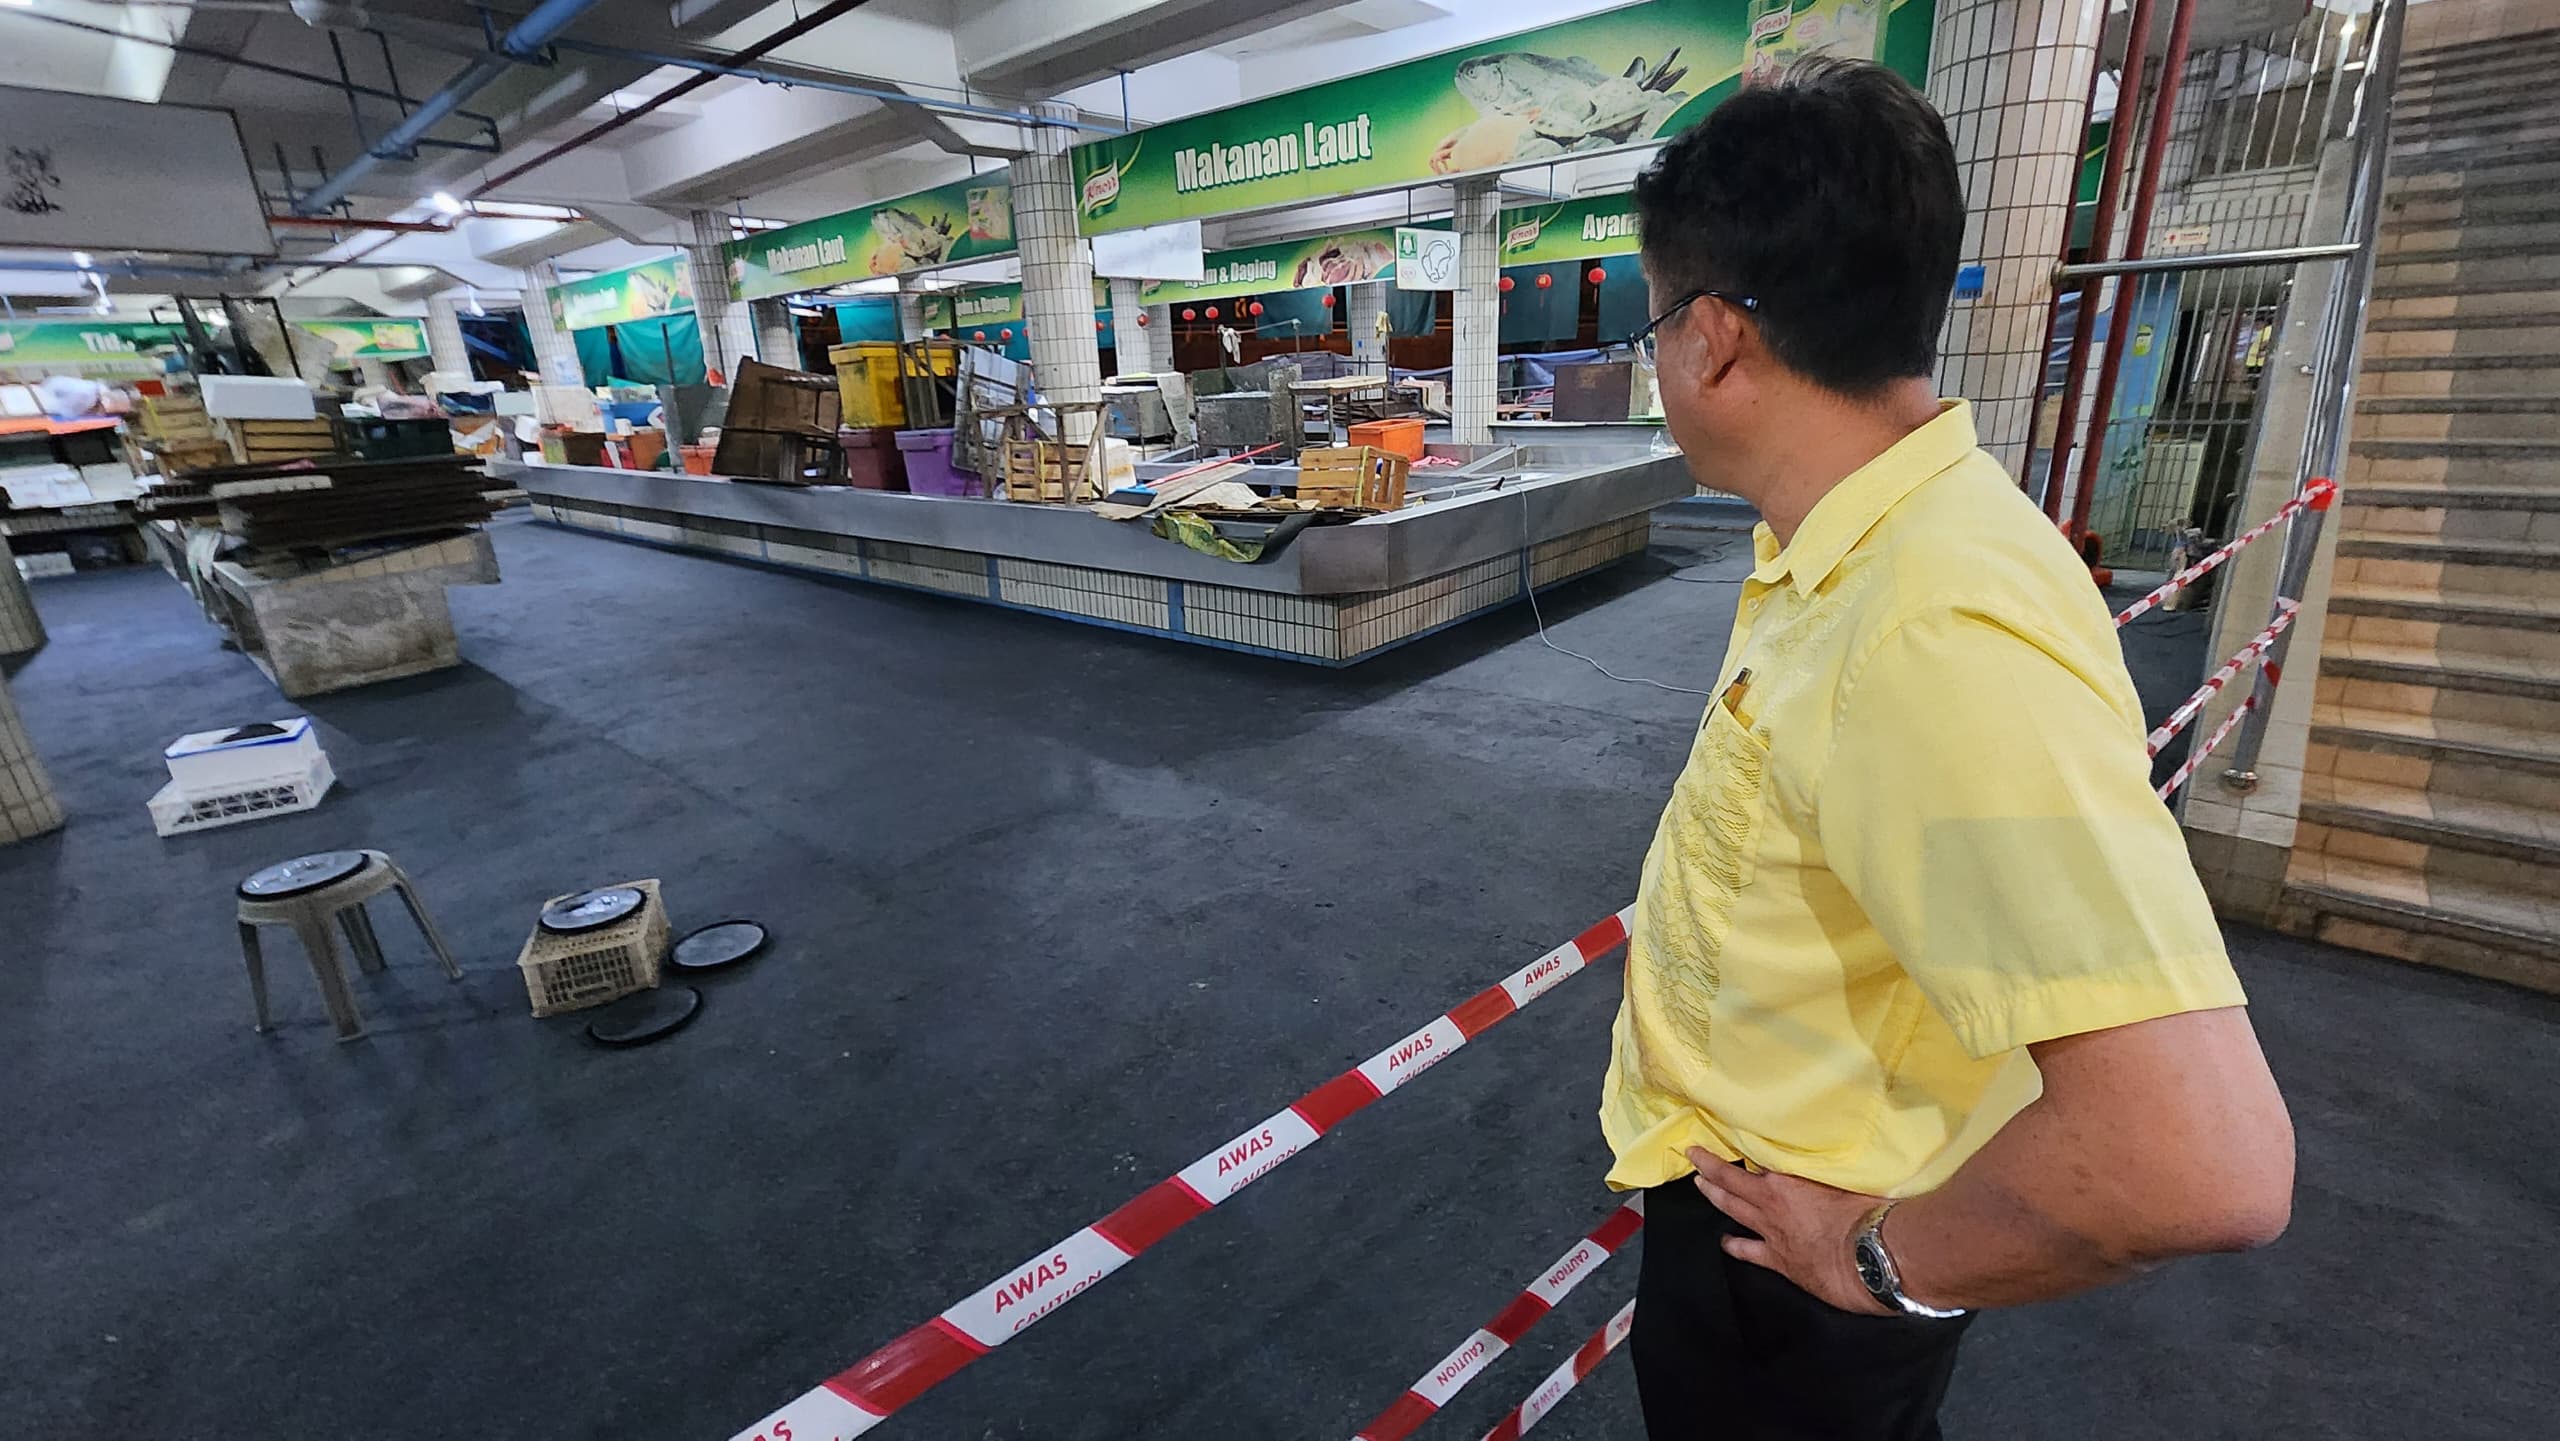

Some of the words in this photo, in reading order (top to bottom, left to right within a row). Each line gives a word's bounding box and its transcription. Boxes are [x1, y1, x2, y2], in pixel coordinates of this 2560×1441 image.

[1175, 133, 1297, 191] Makanan
[1304, 114, 1370, 167] Laut
[1086, 176, 1118, 200] Knorr
[766, 244, 820, 274] Makanan
[817, 234, 846, 265] Laut
[1510, 227, 1537, 241] Knorr
[1219, 266, 1229, 283] &
[1230, 259, 1277, 282] Daging
[1524, 955, 1561, 987] AWAS
[1389, 1033, 1433, 1071] AWAS
[1217, 1129, 1273, 1176] AWAS
[1230, 1145, 1297, 1193] CAUTION
[994, 1254, 1069, 1313] AWAS
[1548, 1249, 1589, 1288] CAUTION
[1013, 1270, 1102, 1331] CAUTION
[1436, 1341, 1485, 1386] CAUTION
